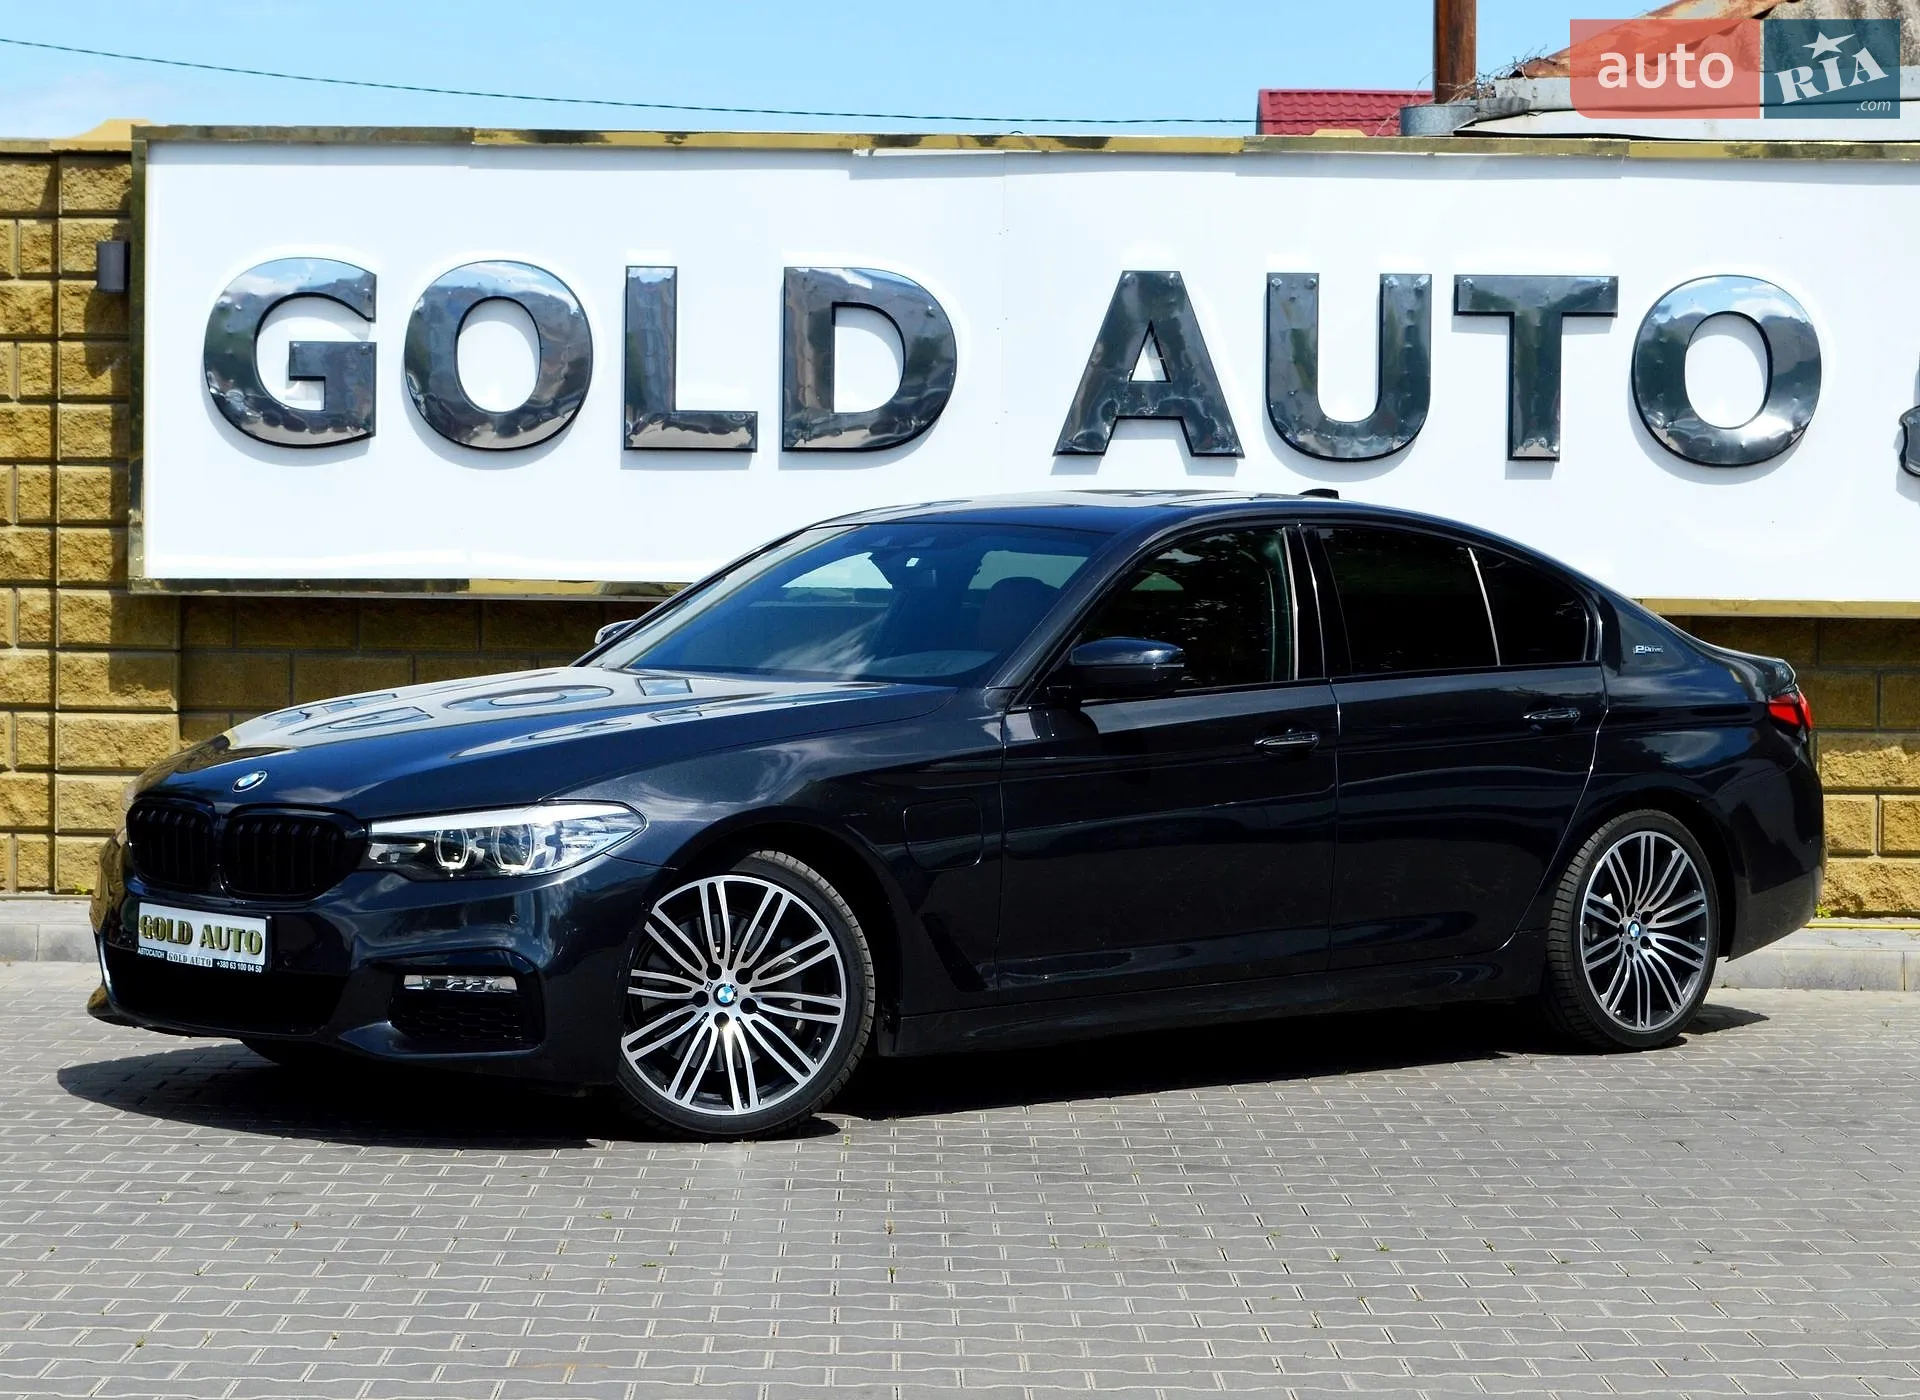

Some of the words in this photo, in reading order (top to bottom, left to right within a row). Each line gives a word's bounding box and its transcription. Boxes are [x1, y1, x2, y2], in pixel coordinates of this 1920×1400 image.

[203, 257, 957, 452] GOLD
[1053, 270, 1822, 467] AUTO
[139, 915, 193, 945] GOLD
[200, 924, 263, 955] AUTO
[168, 952, 188, 963] GOLD
[190, 956, 212, 967] AUTO
[216, 960, 229, 969] +380
